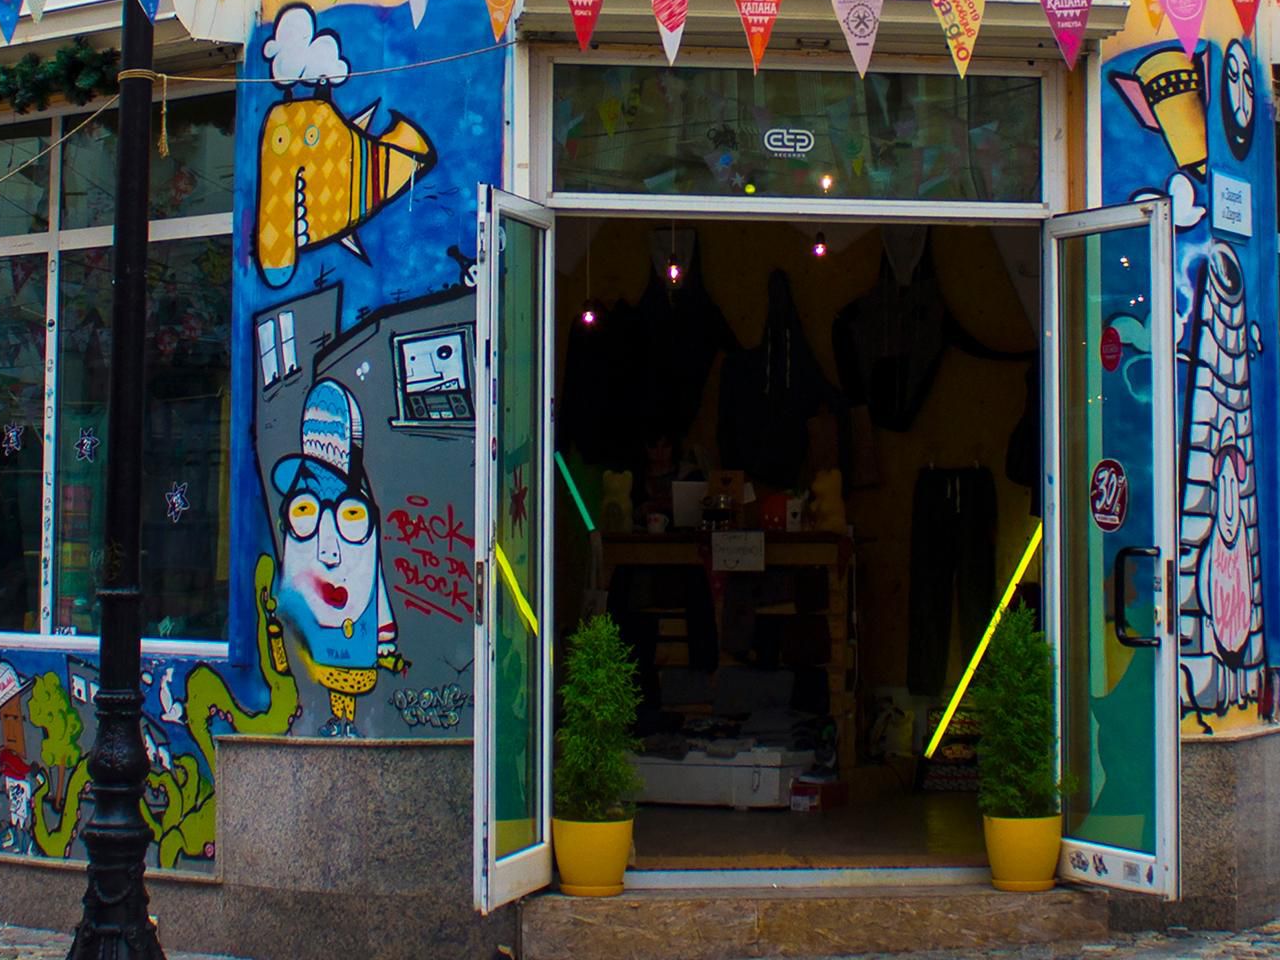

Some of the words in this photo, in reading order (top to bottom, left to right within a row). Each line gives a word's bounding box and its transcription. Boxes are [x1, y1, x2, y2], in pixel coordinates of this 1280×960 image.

[741, 1, 778, 16] КАПАНА
[387, 503, 475, 552] BACK
[394, 554, 475, 614] BLOCK
[412, 548, 440, 569] TO
[449, 557, 472, 583] DA
